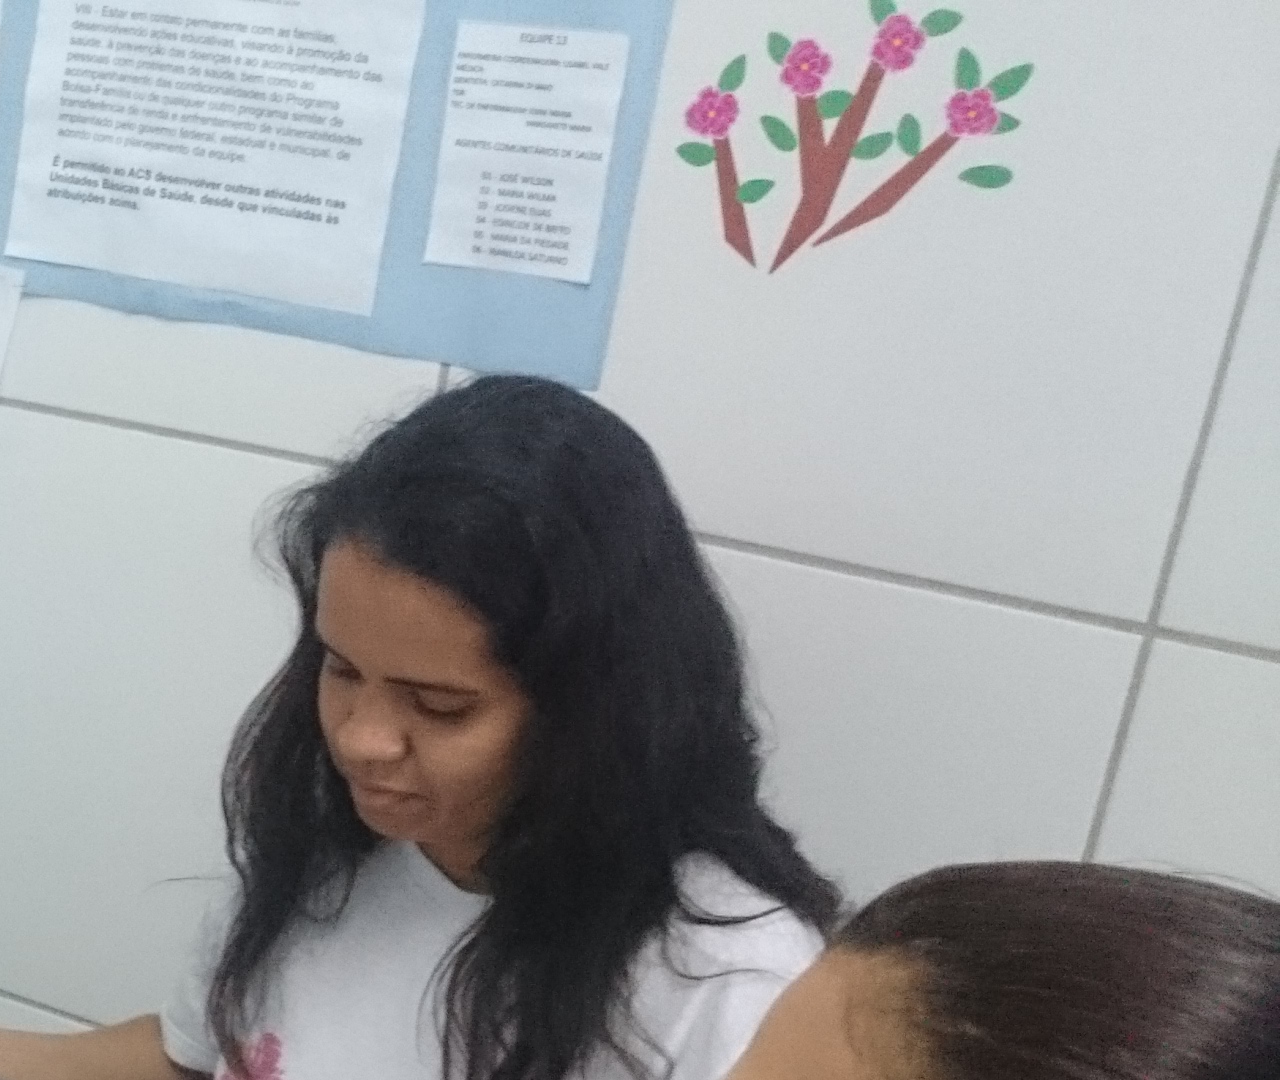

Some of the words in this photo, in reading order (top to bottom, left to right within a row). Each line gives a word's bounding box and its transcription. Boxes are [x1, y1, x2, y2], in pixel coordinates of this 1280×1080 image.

[102, 6, 128, 19] Estar
[186, 18, 247, 33] permanente
[252, 26, 274, 35] com
[296, 48, 351, 62] promoção
[355, 53, 368, 64] da
[267, 77, 297, 89] como
[300, 81, 314, 91] ao
[286, 93, 340, 111] Programa
[238, 106, 288, 121] programa
[331, 117, 344, 128] de
[50, 172, 98, 188] Unidades
[143, 187, 156, 198] de
[201, 195, 234, 209] desde
[238, 202, 258, 213] que
[262, 207, 322, 223] vinculadas
[156, 172, 221, 190] desenvolver
[225, 184, 260, 197] outras
[264, 189, 321, 206] atividades
[326, 199, 346, 210] nas
